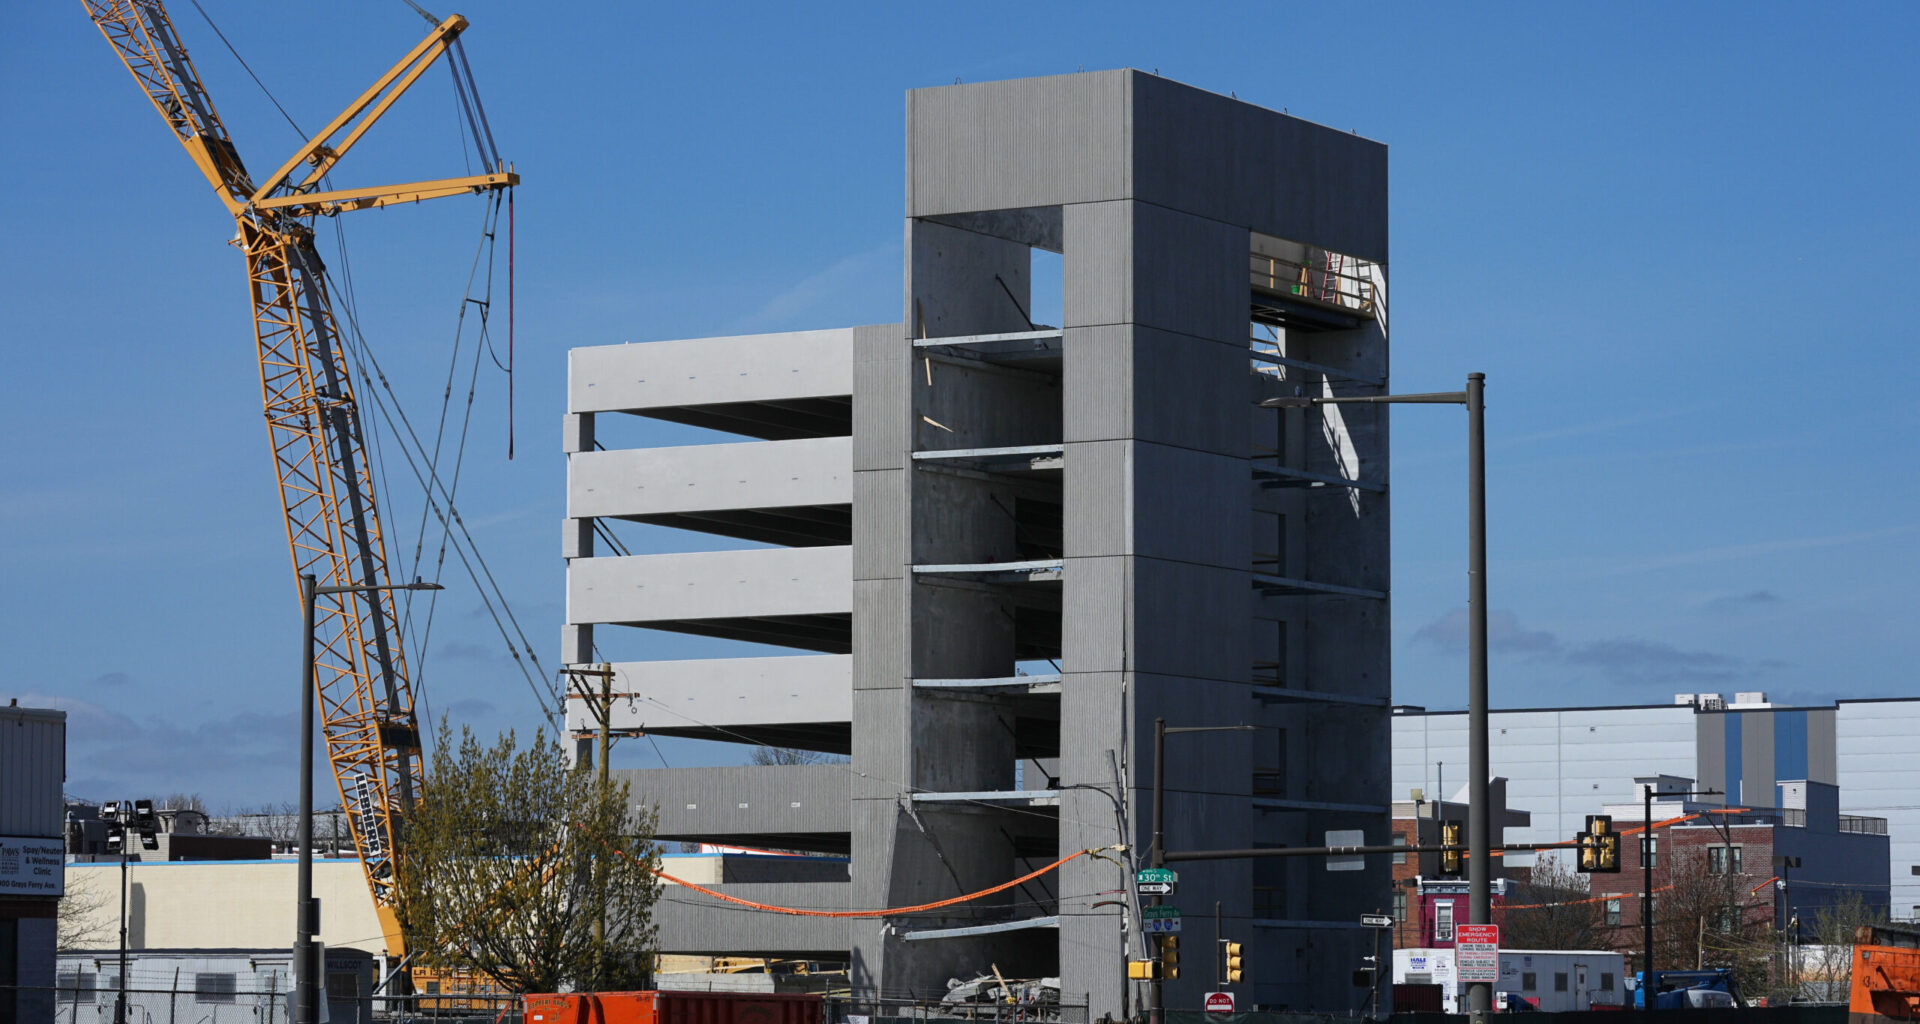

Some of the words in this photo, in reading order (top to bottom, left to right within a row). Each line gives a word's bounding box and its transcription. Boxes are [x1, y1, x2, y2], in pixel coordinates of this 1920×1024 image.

[355, 774, 379, 853] LIEBHERR
[2, 848, 20, 856] PAWS
[22, 845, 63, 856] Spay/Neuter
[32, 857, 60, 865] Wellness
[33, 867, 52, 876] Clinic
[11, 880, 26, 888] Grays
[28, 881, 43, 890] Ferry
[1160, 910, 1172, 918] Ferry
[327, 960, 362, 969] WILLSCOT
